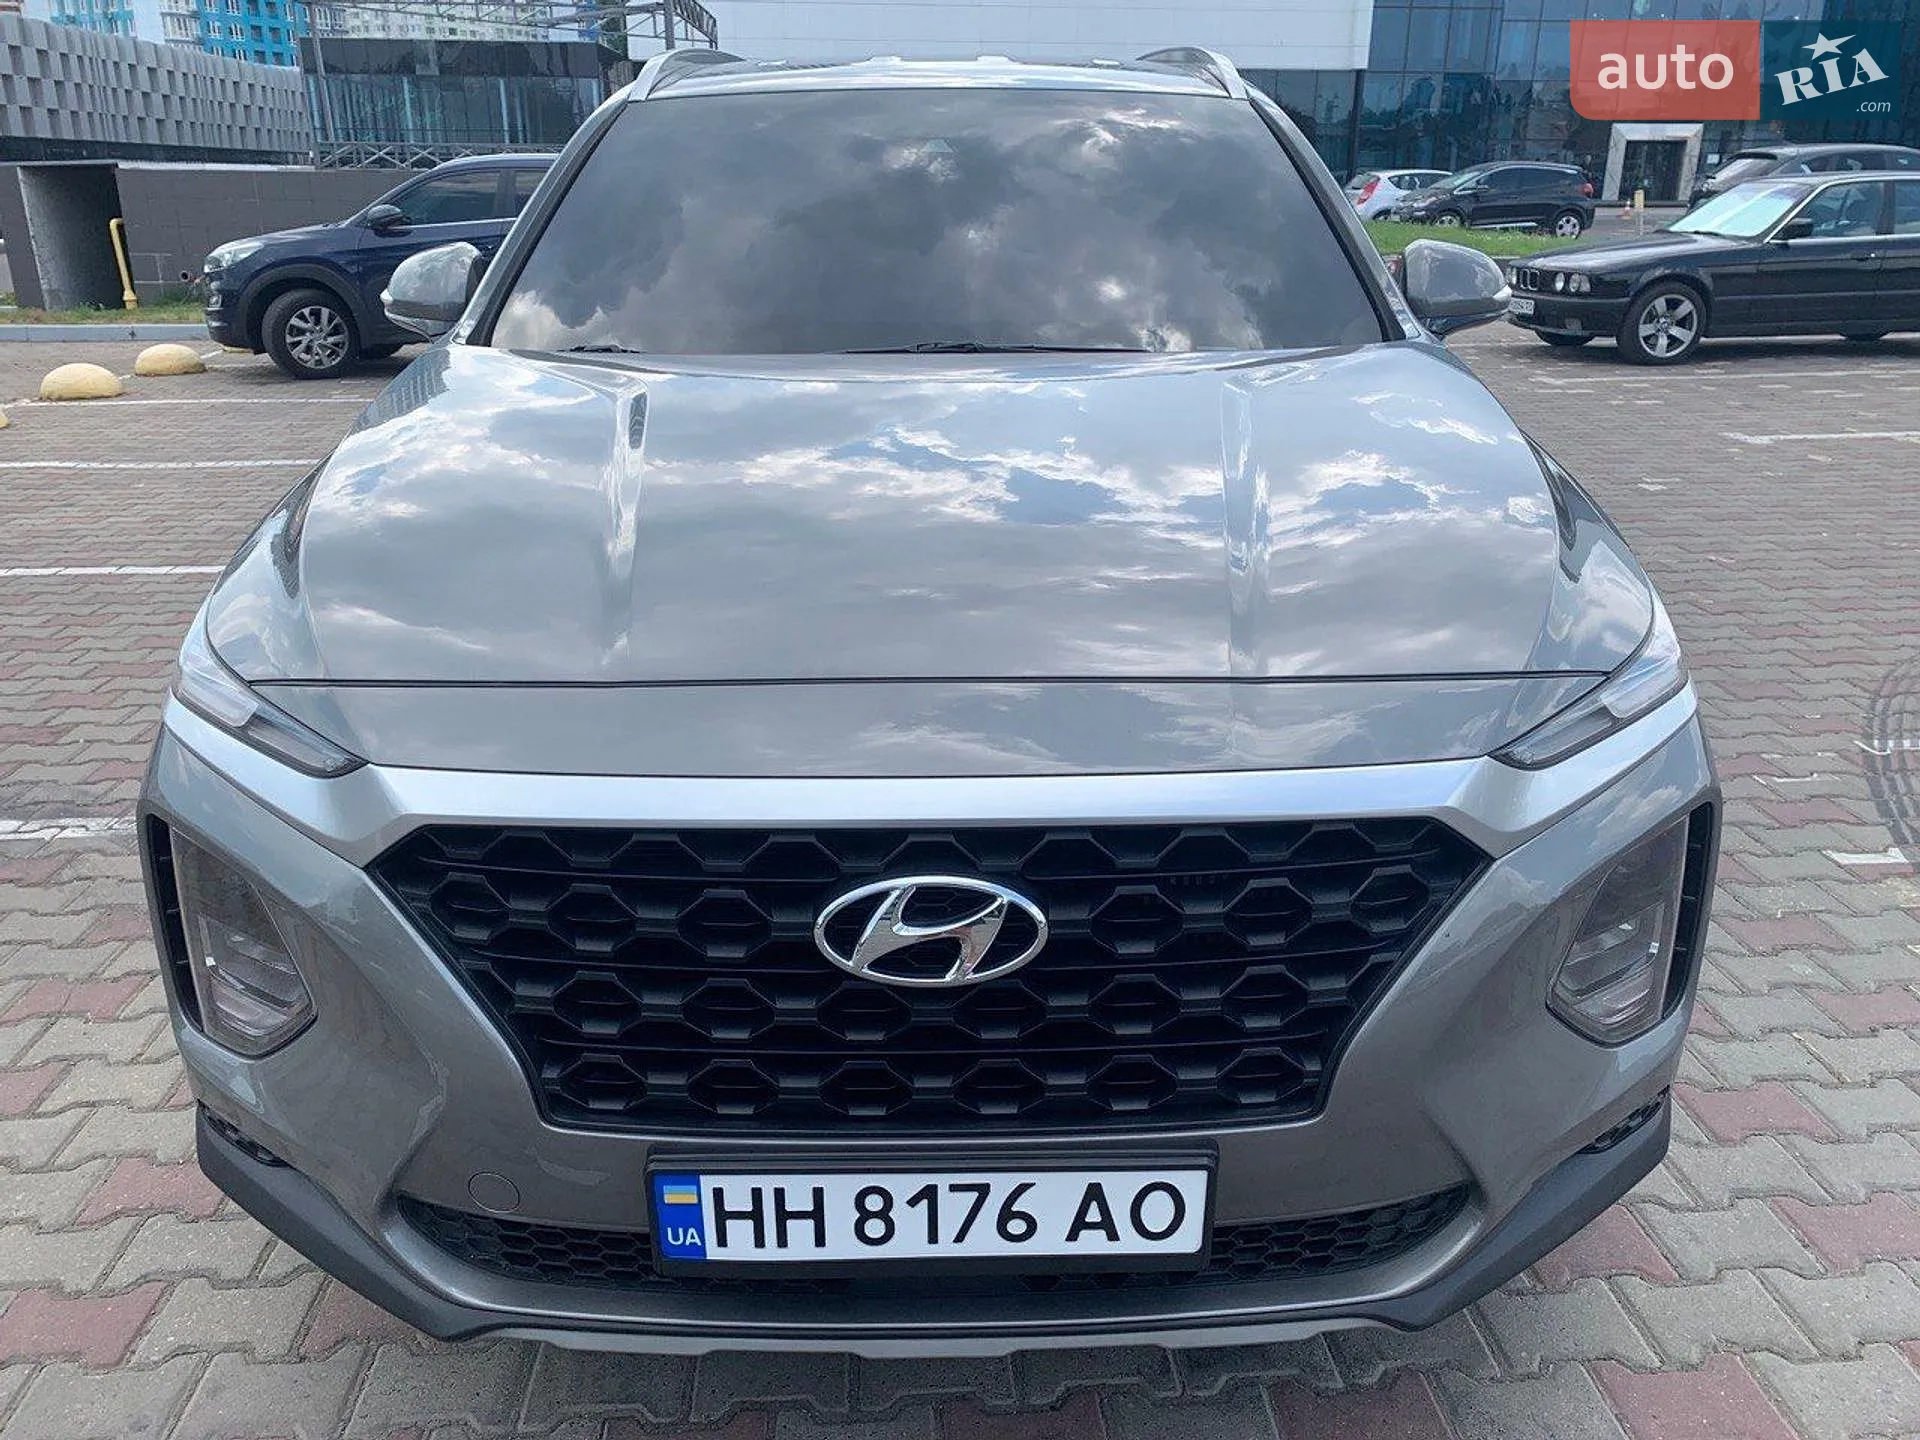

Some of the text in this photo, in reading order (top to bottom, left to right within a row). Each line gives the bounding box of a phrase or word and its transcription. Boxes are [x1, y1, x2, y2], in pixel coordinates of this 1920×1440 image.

[667, 1227, 701, 1247] UA
[712, 1181, 1187, 1249] HH 8176 AO
